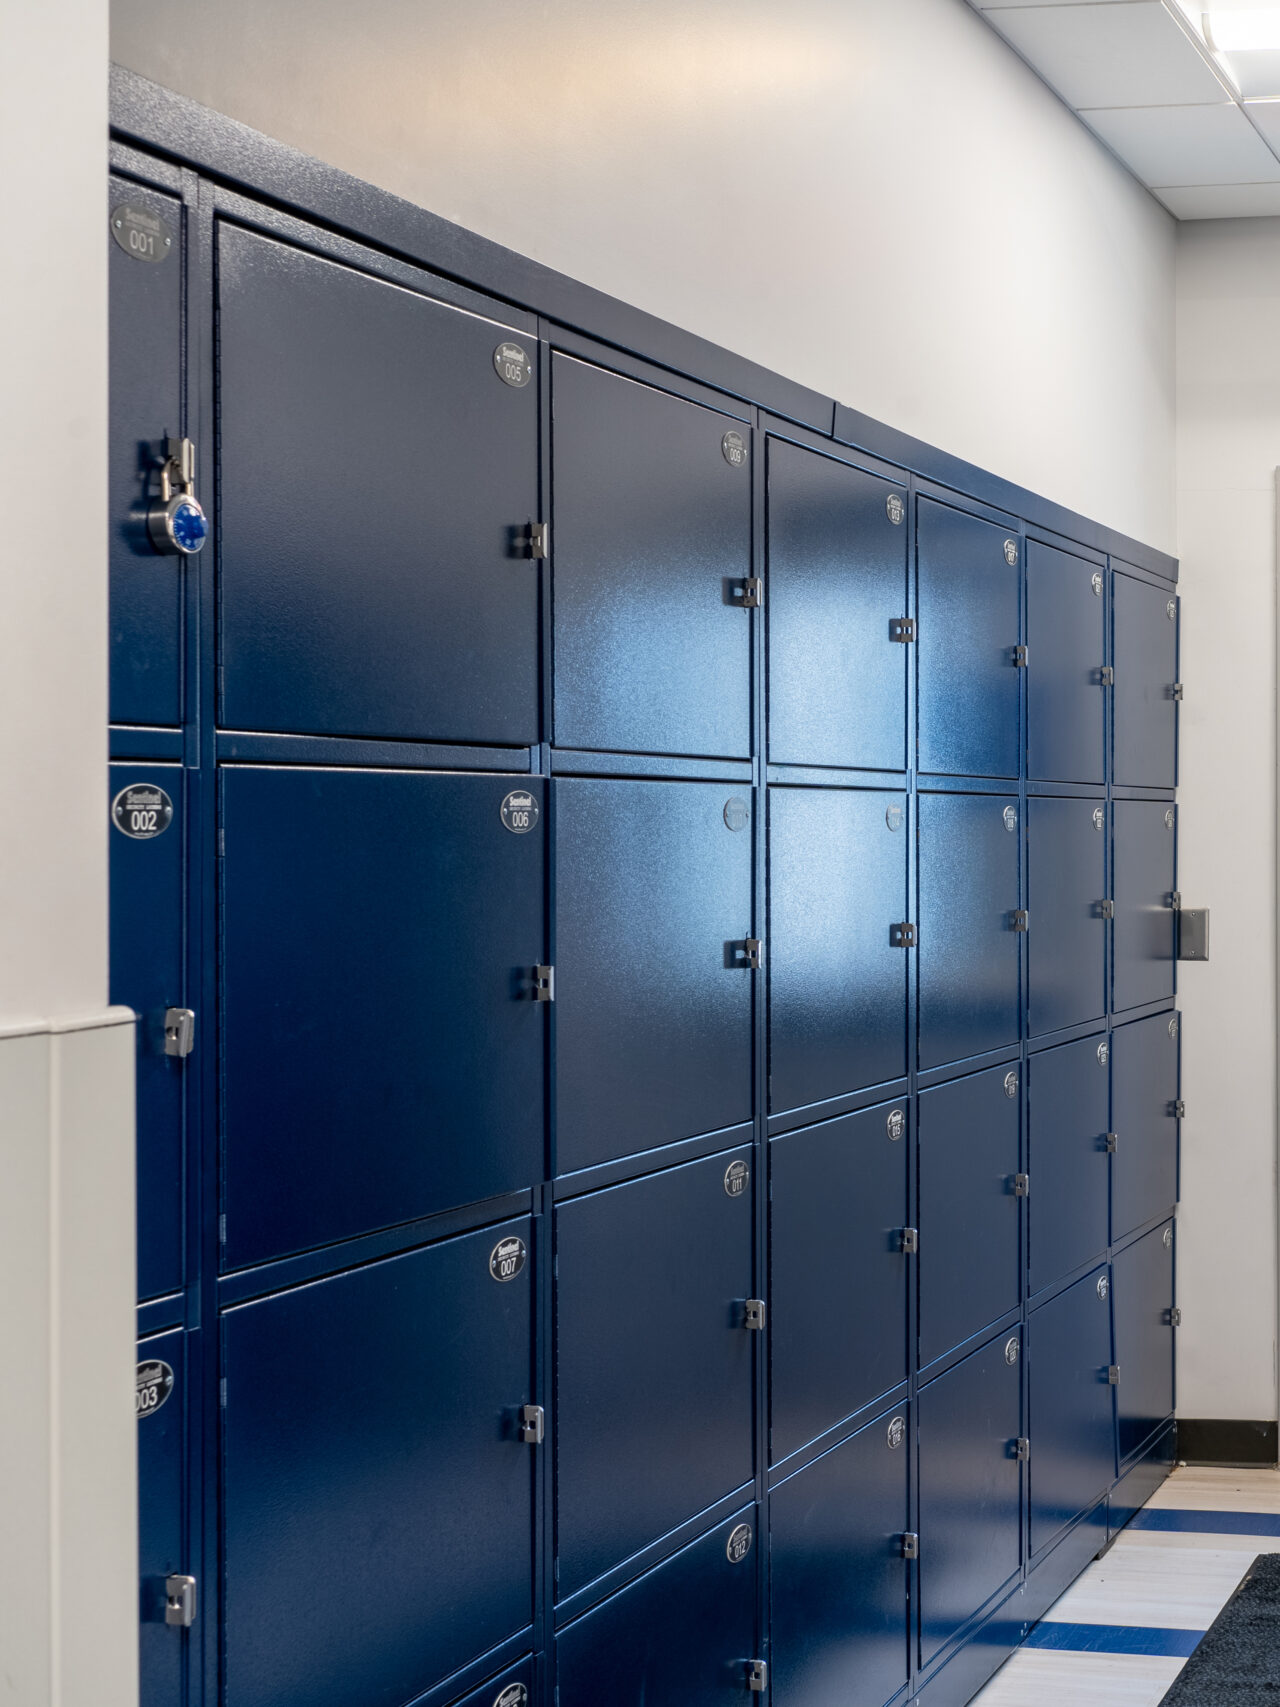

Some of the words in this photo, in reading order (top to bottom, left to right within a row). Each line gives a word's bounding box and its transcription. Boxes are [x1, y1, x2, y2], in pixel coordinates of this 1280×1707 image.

[130, 229, 154, 255] 001
[505, 363, 521, 382] 005
[509, 796, 532, 806] Sentinel
[131, 811, 157, 831] 002
[512, 811, 529, 827] 006
[732, 1177, 742, 1192] 011
[500, 1257, 517, 1276] 007
[735, 1541, 746, 1558] 012
